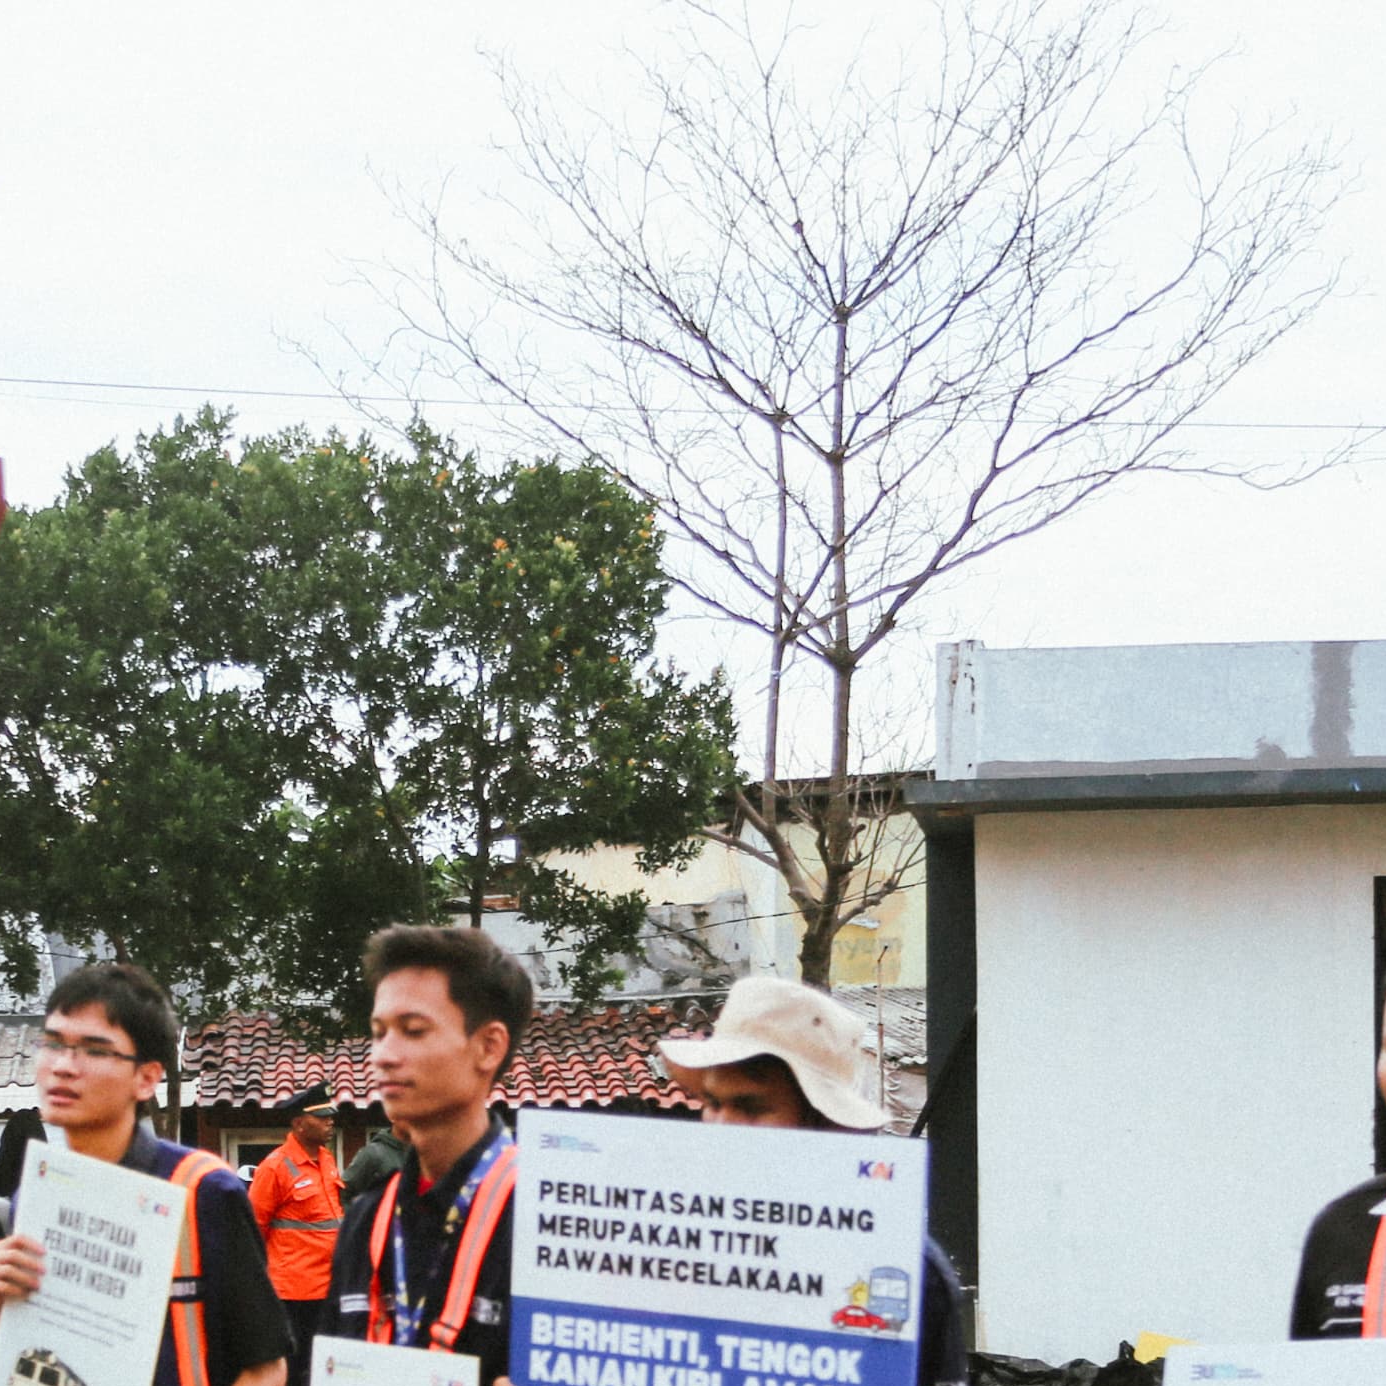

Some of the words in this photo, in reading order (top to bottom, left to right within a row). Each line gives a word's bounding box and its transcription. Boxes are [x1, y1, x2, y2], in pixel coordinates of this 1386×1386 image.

[58, 1206, 84, 1231] MARI
[539, 1180, 725, 1219] PERLINTASAN
[733, 1198, 875, 1233] SEBIDANG
[537, 1213, 702, 1250] MERUPAKAN
[710, 1229, 779, 1258] TITIK
[537, 1246, 634, 1277] RAWAN
[640, 1257, 824, 1298] KECELAKAAN
[531, 1312, 710, 1369] BERHENTI,
[716, 1335, 863, 1385] TENGOK
